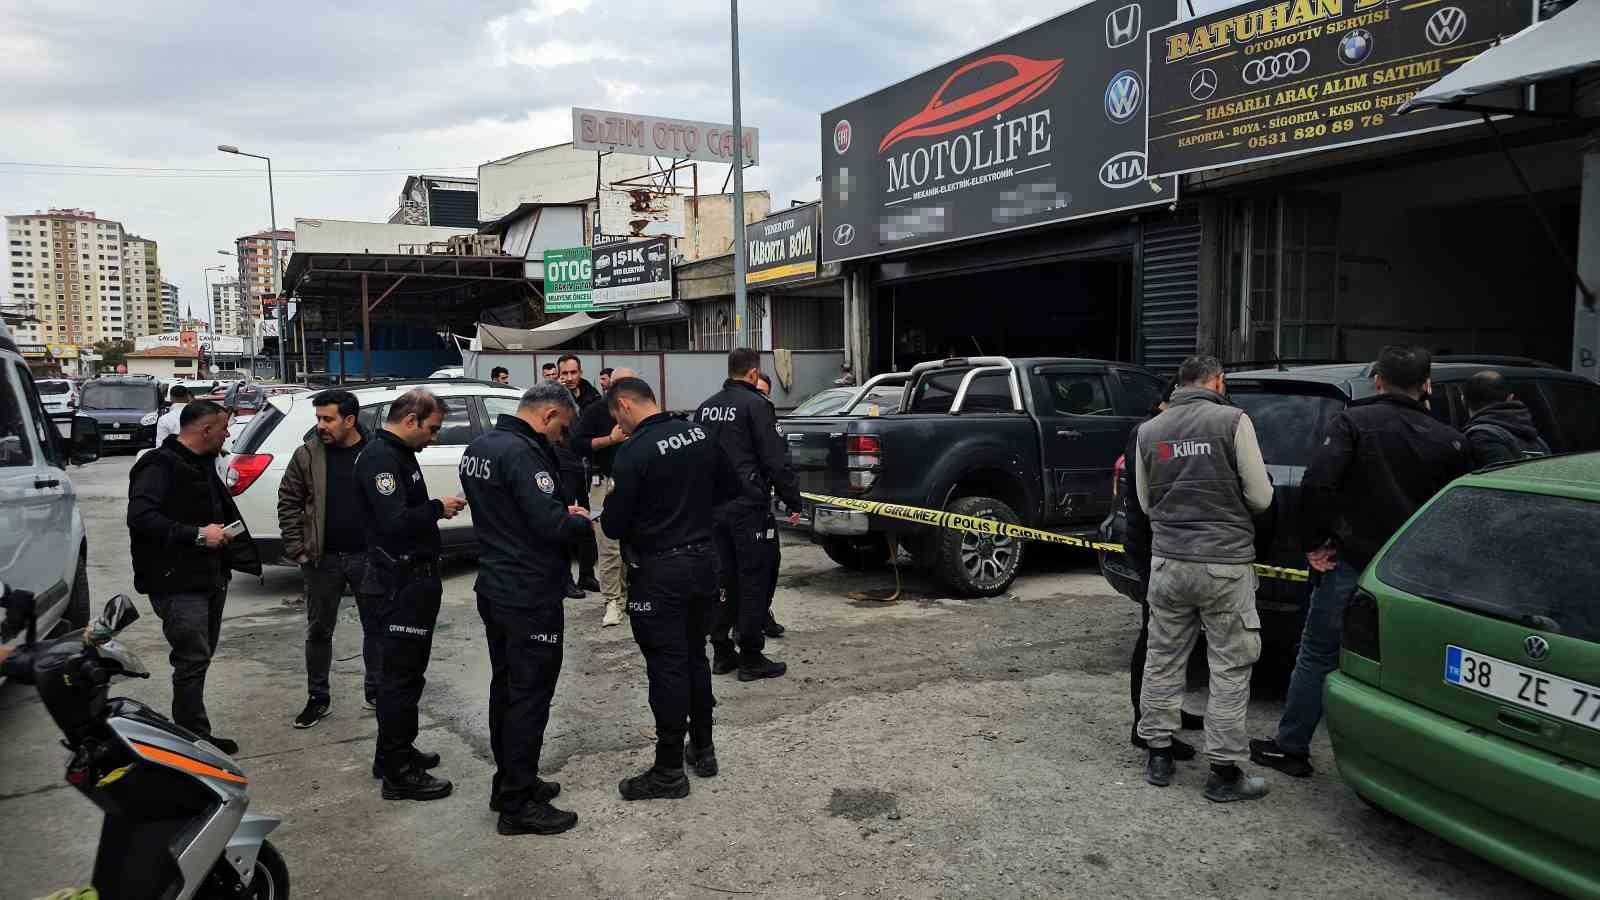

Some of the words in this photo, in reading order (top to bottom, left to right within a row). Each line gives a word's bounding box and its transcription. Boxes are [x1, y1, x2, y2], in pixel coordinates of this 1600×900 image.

[1166, 0, 1342, 64] BATUHAN
[1243, 25, 1322, 56] OTOMOTİV
[1206, 95, 1271, 121] HASARLI
[1275, 84, 1318, 110] ARAÇ
[1322, 69, 1369, 97] ALIM
[1373, 59, 1441, 85] SATIMI
[653, 122, 698, 153] OTO
[707, 128, 753, 159] CAM
[1178, 129, 1225, 148] KAPORTA
[1232, 122, 1261, 137] BOYA
[1269, 111, 1320, 129] SİGORTA
[1329, 99, 1372, 118] KASKO
[1248, 134, 1288, 149] 0531
[1294, 125, 1327, 141] 820
[1331, 121, 1354, 135] 89
[1361, 113, 1385, 128] 78
[886, 108, 1051, 193] MOTOLİFE
[1107, 158, 1142, 182] KIA
[612, 247, 645, 268] IŞIK
[749, 238, 786, 267] KABORTA
[789, 224, 813, 259] BOYA
[1172, 441, 1212, 458] kilim
[1463, 656, 1492, 688] 38
[1517, 672, 1550, 707] ZE
